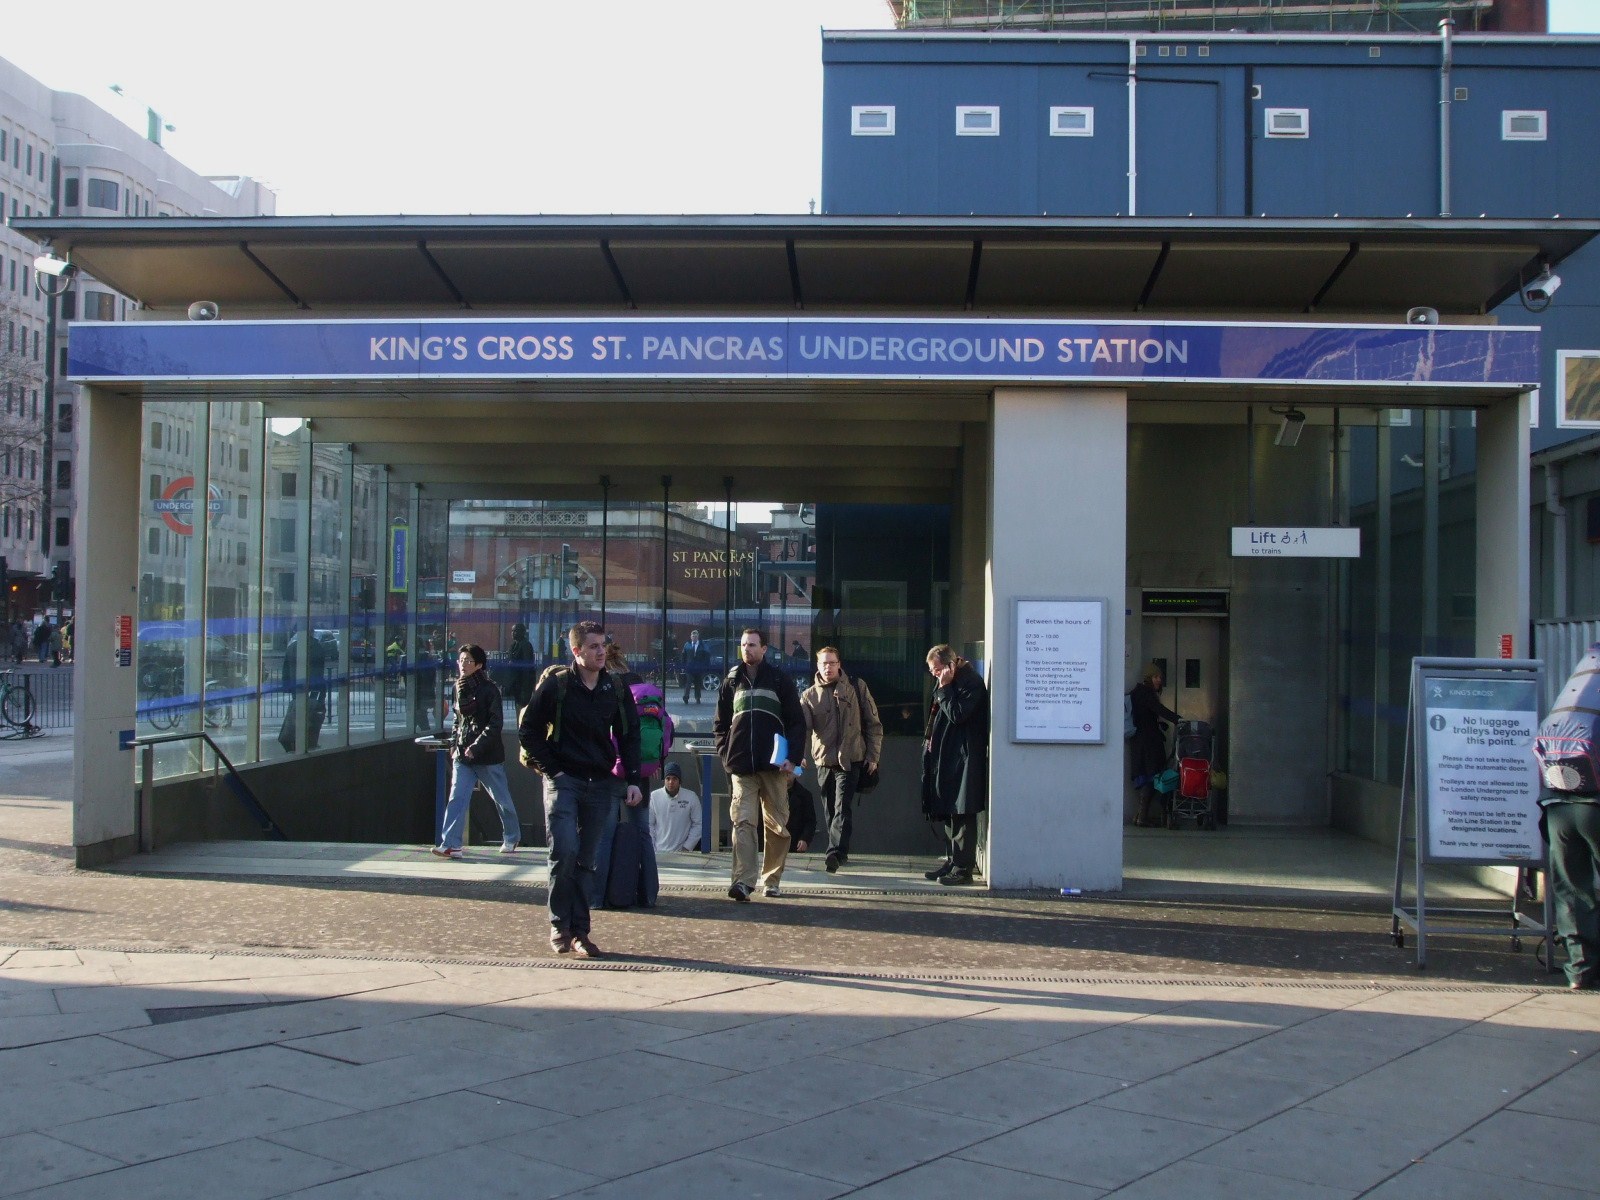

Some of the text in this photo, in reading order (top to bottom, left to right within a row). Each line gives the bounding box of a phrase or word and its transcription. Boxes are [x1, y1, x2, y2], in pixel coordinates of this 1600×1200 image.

[370, 336, 1189, 364] KING'S CROSS ST. PANCRAS UNDERGROUND STATION
[1251, 532, 1276, 544] Lift
[672, 551, 755, 563] ST PANCRAS
[684, 568, 742, 579] STATION
[1480, 717, 1520, 728] luggage
[1453, 726, 1530, 738] trolleys beyond
[1467, 737, 1516, 746] this point.
